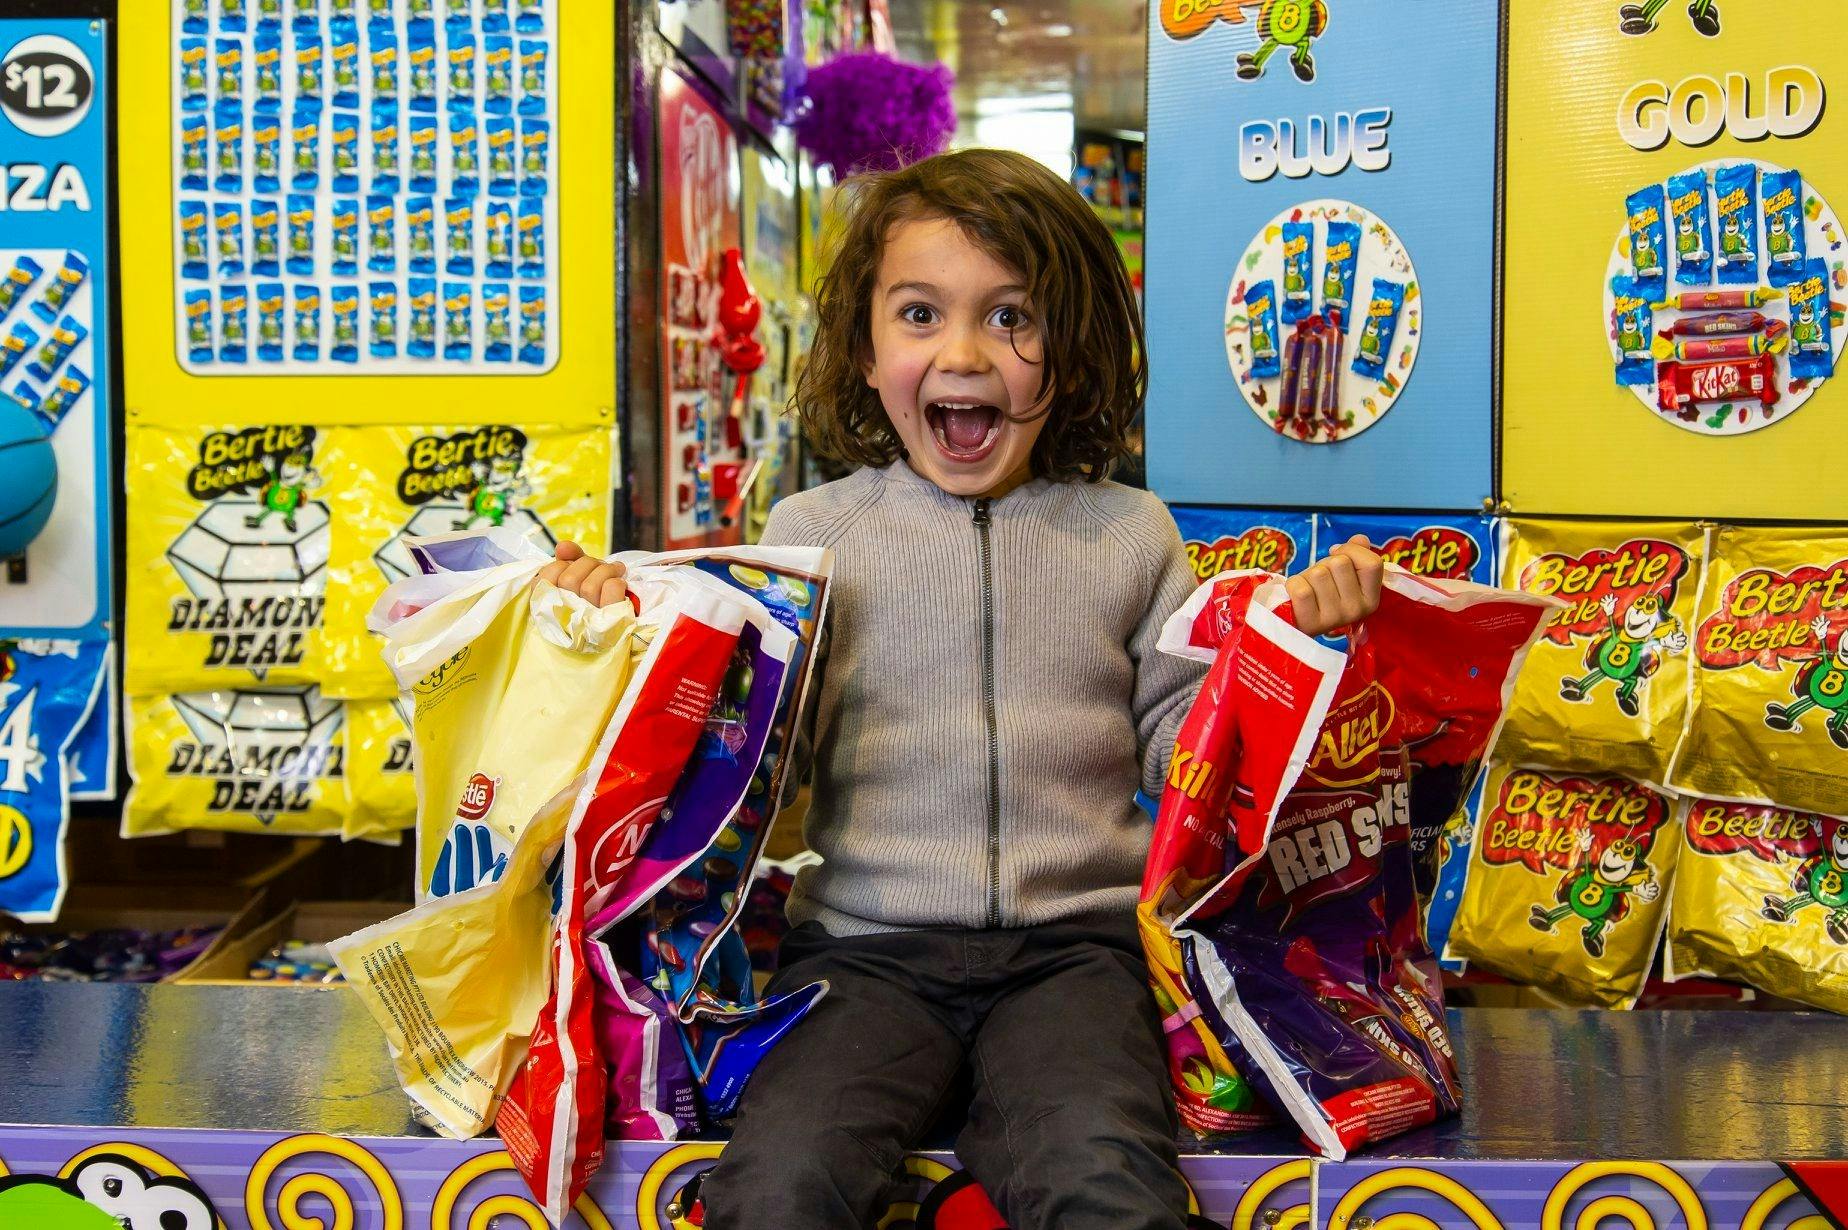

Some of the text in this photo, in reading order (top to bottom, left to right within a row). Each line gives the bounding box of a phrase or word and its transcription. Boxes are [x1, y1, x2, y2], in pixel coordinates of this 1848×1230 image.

[5, 61, 78, 108] $12
[1617, 66, 1825, 150] GOLD
[1239, 107, 1391, 182] BLUE
[1695, 366, 1739, 398] KitKat
[202, 428, 303, 464] Bertie
[412, 429, 514, 470] Bertie
[1531, 543, 1671, 595] Bertie
[169, 598, 325, 631] DIAMON
[204, 633, 305, 666] DEAL
[1706, 619, 1811, 652] Beetle
[208, 780, 311, 812] DEAL
[1305, 797, 1357, 825] Raspberry,
[1505, 775, 1649, 825] Bertie
[1490, 822, 1574, 852] Beetle
[1701, 806, 1808, 837] Beetle
[1269, 821, 1352, 896] RED
[436, 1080, 461, 1111] RECYCLABLE
